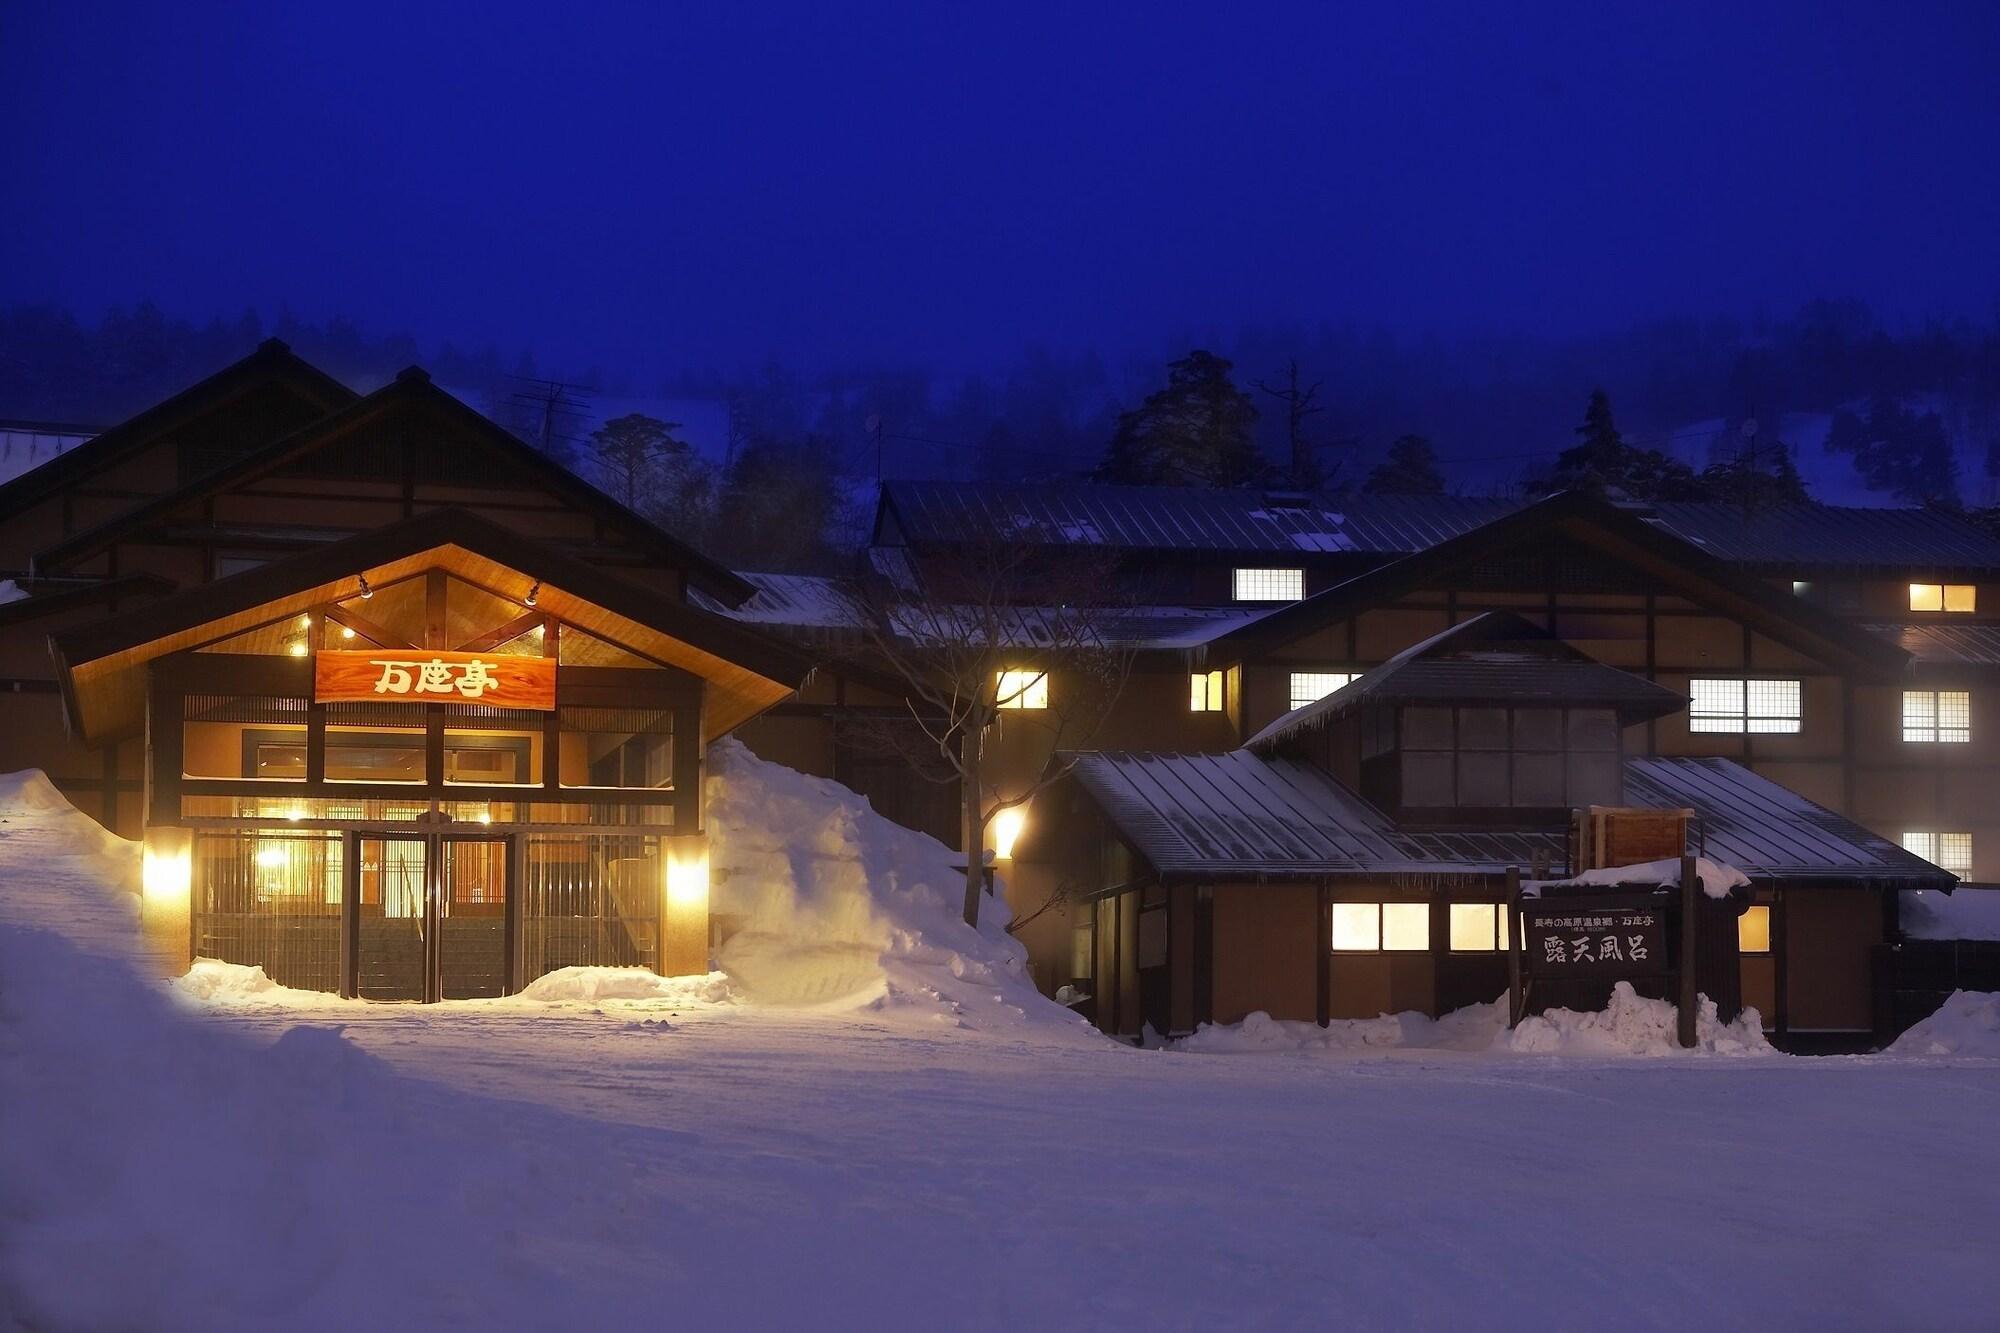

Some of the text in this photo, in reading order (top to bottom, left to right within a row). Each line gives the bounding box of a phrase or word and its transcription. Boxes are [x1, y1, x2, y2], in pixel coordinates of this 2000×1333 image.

[369, 658, 499, 698] 万座亭
[1544, 935, 1648, 963] 露天風呂
